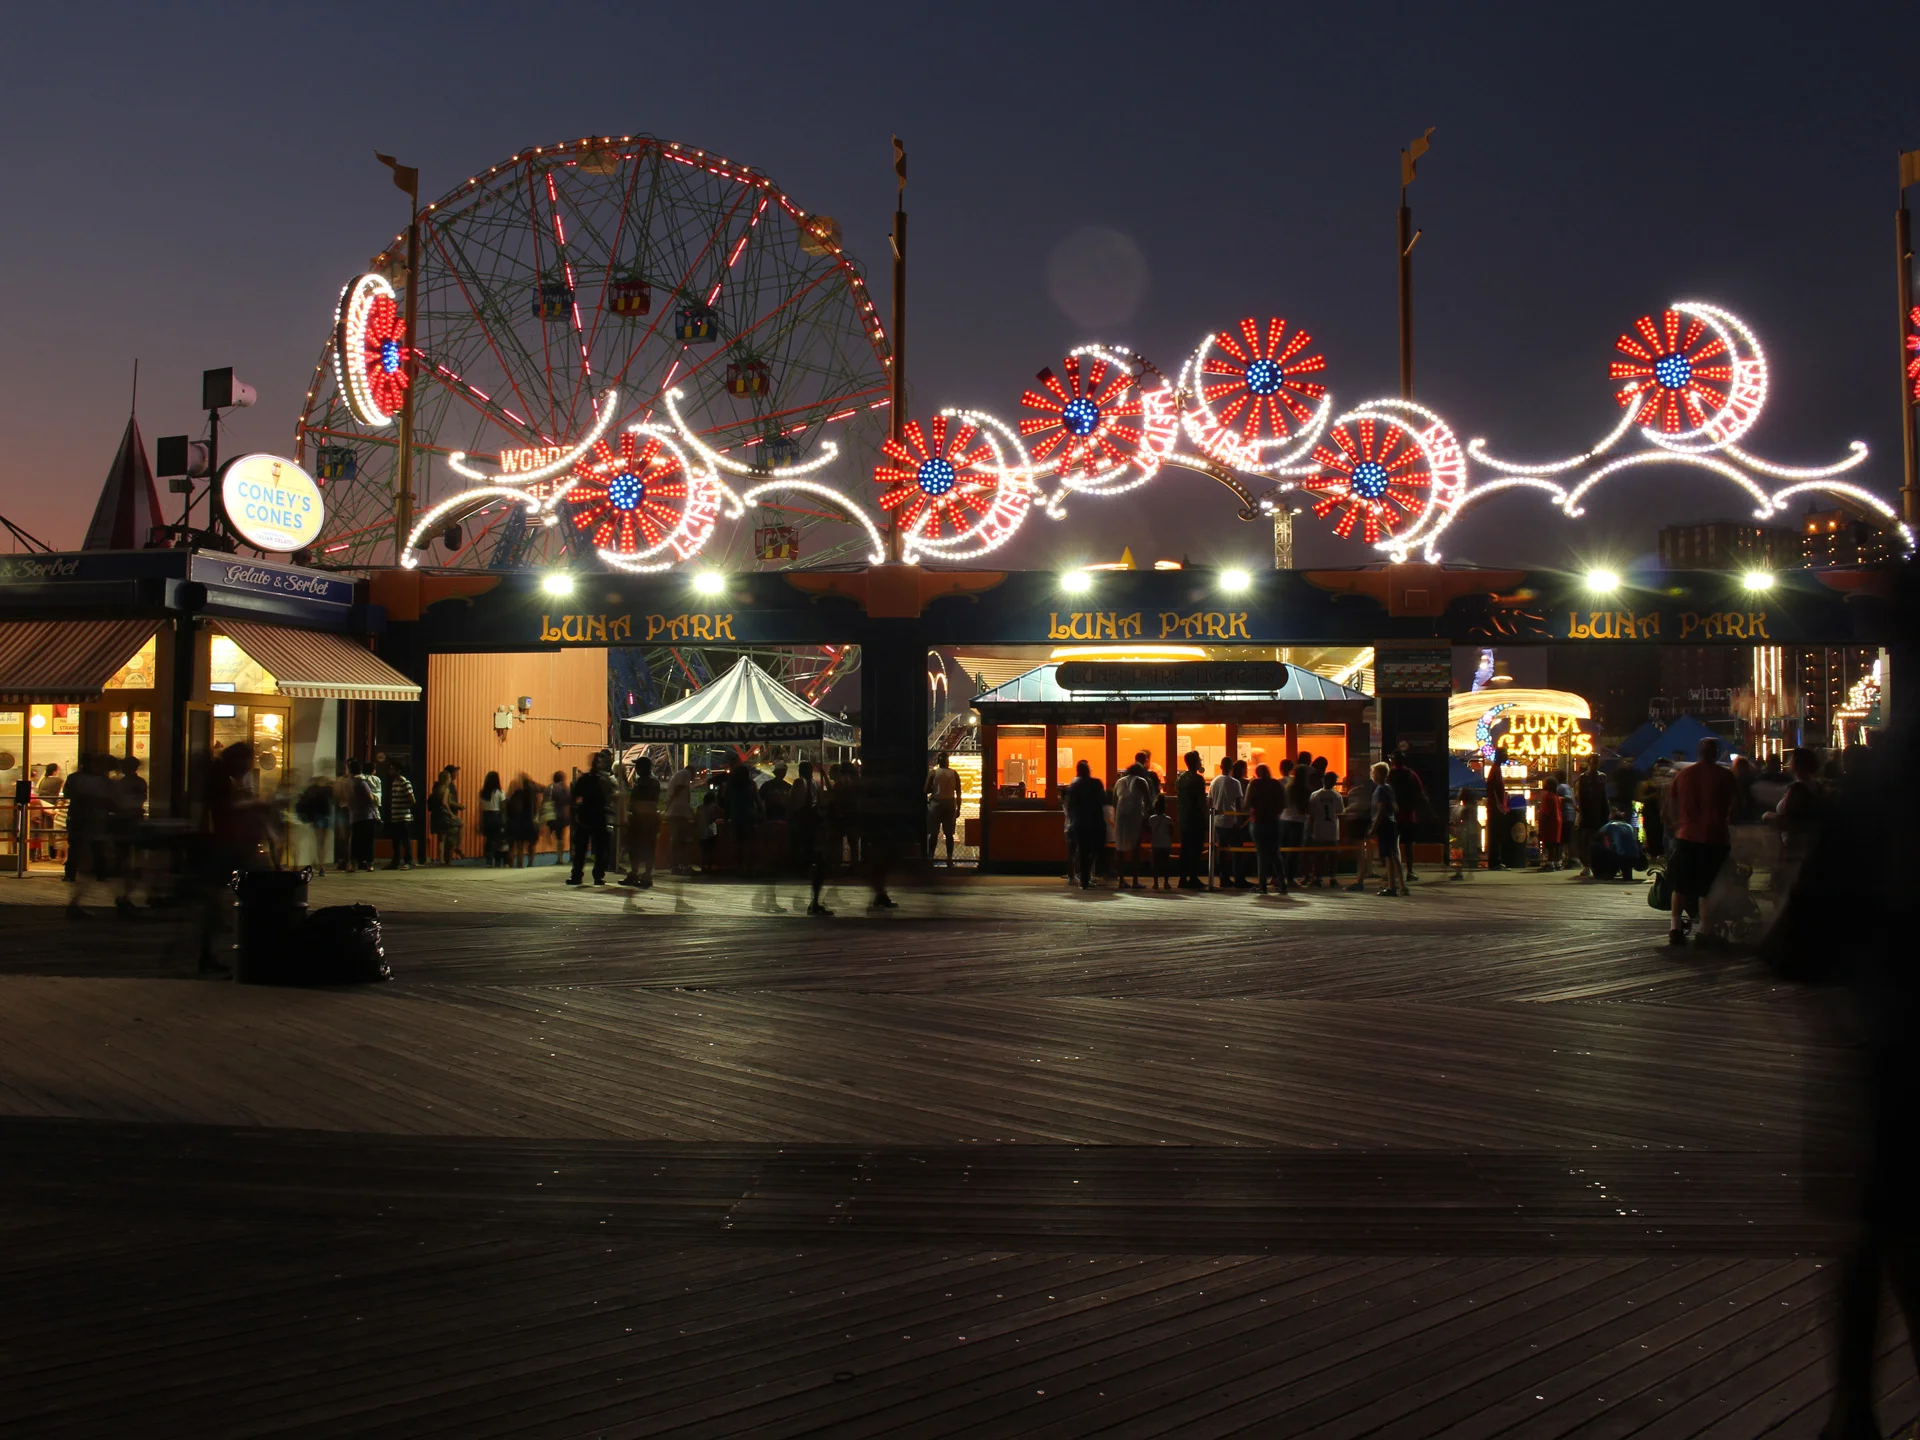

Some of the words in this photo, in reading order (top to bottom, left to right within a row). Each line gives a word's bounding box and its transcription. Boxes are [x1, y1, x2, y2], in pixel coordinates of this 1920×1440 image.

[238, 481, 311, 512] CONEY'S
[245, 503, 303, 529] CONES
[15, 558, 80, 579] Sorbet
[224, 564, 271, 585] Gelato
[273, 576, 283, 588] &
[283, 574, 329, 596] Sorbet
[540, 613, 632, 642] LUNA
[646, 613, 736, 641] PARK
[1048, 611, 1142, 640] LUNA
[1159, 611, 1251, 639] PARK
[1568, 611, 1661, 639] LUNA
[1680, 611, 1770, 639] PARK
[630, 722, 816, 740] LunaParkNYC.com
[1509, 713, 1581, 734] LUNA
